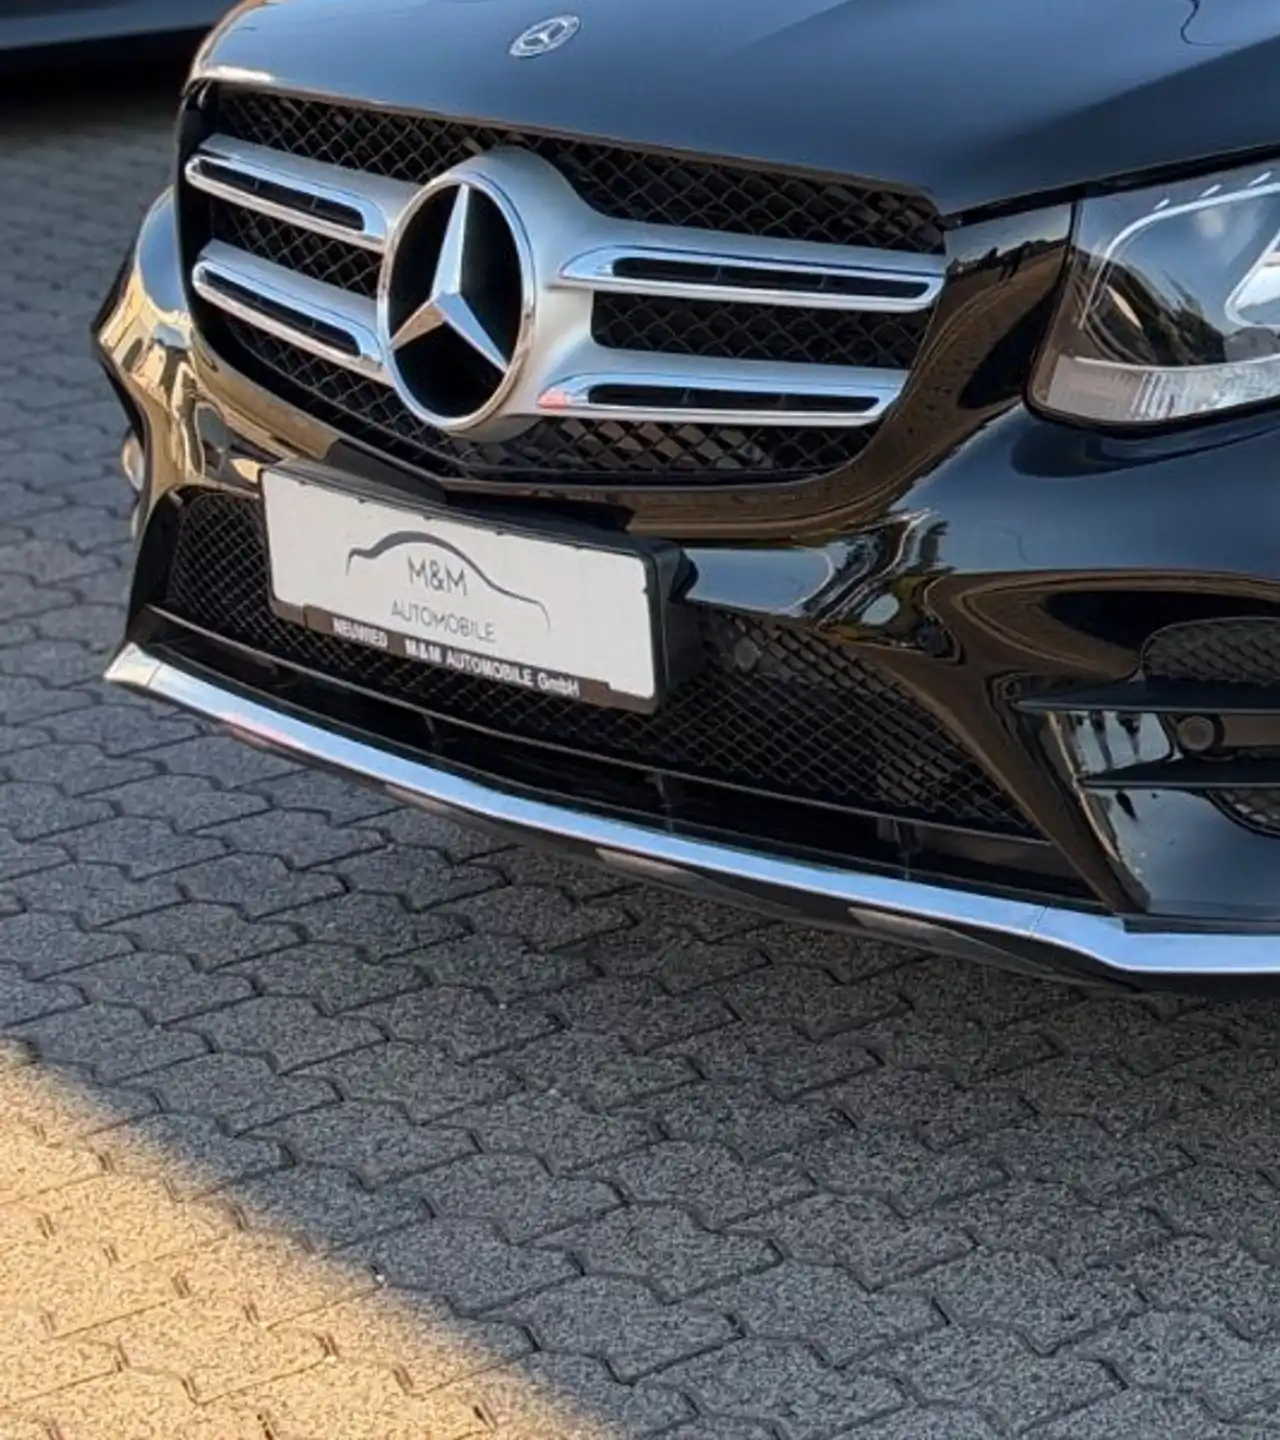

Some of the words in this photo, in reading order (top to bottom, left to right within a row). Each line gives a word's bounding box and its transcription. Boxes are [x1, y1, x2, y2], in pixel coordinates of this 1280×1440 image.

[408, 557, 468, 596] M&M
[391, 599, 496, 643] AUTOMOBILE
[404, 637, 442, 664] M&M
[447, 649, 533, 686] AUTOMOBILE
[538, 671, 580, 698] GmbH
